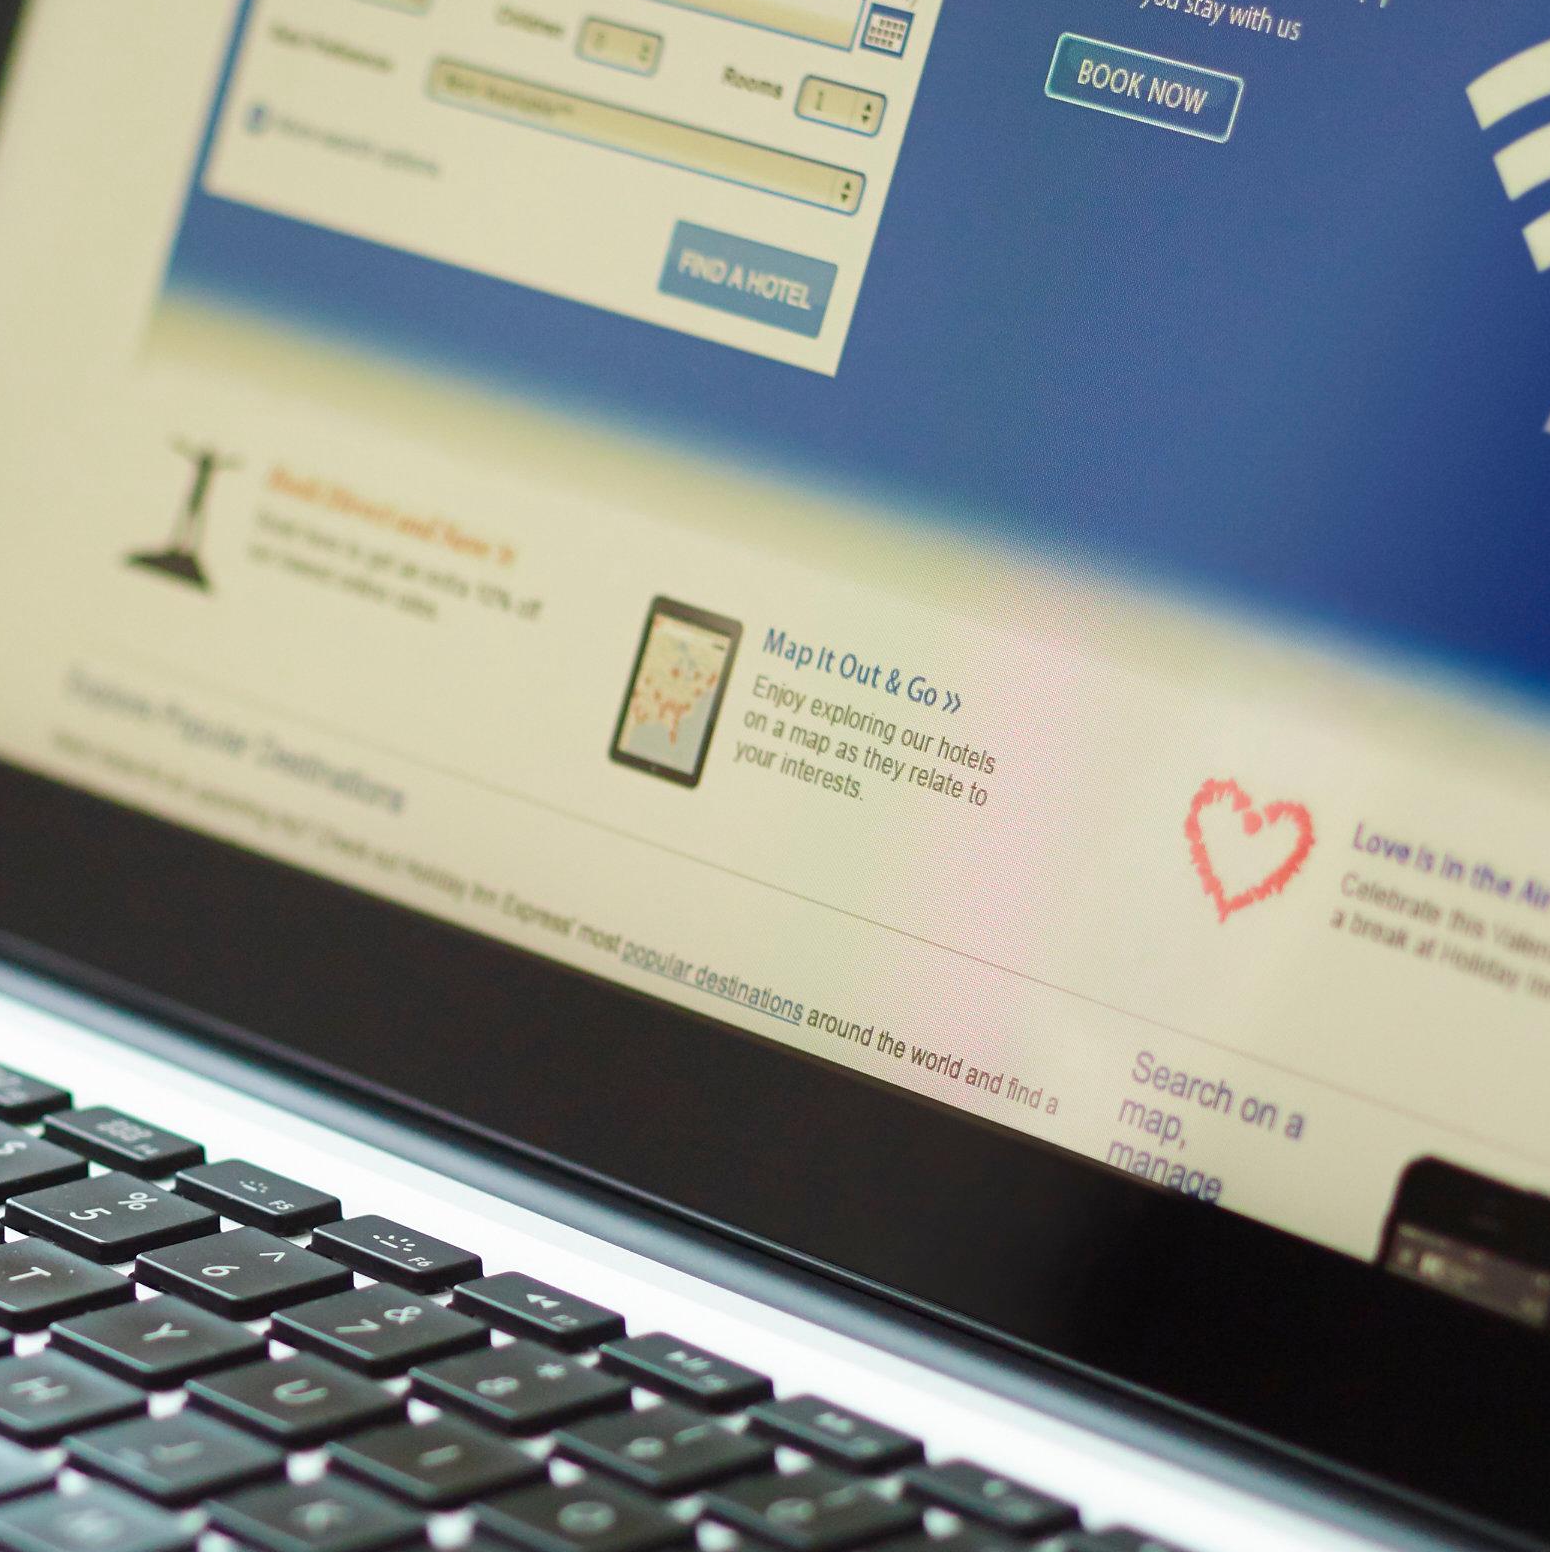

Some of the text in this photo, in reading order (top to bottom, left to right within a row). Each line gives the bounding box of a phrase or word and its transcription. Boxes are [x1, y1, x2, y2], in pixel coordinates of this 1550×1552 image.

[1229, 4, 1272, 35] with
[1277, 18, 1302, 41] us
[721, 66, 784, 101] Rooms
[1077, 59, 1208, 114] BOOK NOW
[678, 251, 813, 311] FIND A HOTEL
[763, 628, 938, 707] Map It Out & Go
[752, 674, 996, 775] Enjoy exploring our hotels
[733, 742, 865, 801] your interests.
[743, 710, 988, 808] on a map as they relate to
[1352, 821, 1412, 865] Love
[1415, 844, 1434, 873] is
[1440, 853, 1465, 880] in
[1470, 863, 1513, 897] the
[1341, 872, 1442, 926] Celebrate
[1447, 910, 1486, 938] this
[1330, 910, 1345, 929] a
[1350, 913, 1408, 949] break
[1413, 938, 1435, 958] at
[577, 924, 621, 954] most
[622, 939, 692, 987] popular
[696, 965, 803, 1023] destinations
[808, 1005, 873, 1047] around
[878, 1028, 906, 1059] the
[911, 1043, 962, 1080] world
[966, 1065, 1003, 1096] and
[1006, 1078, 1041, 1110] find
[1046, 1095, 1059, 1116] a
[1131, 1049, 1305, 1140] Search on a
[1118, 1092, 1187, 1152] map,
[1106, 1136, 1224, 1201] manage
[70, 1207, 112, 1222] 5
[117, 1191, 158, 1211] %
[268, 1199, 295, 1211] F5
[8, 1266, 51, 1284] T
[201, 1264, 241, 1278] 6
[408, 1255, 431, 1268] F6
[141, 1321, 191, 1342] Y
[335, 1318, 381, 1334] 7
[383, 1305, 422, 1325] &
[7, 1375, 69, 1404] H
[272, 1379, 329, 1405] U
